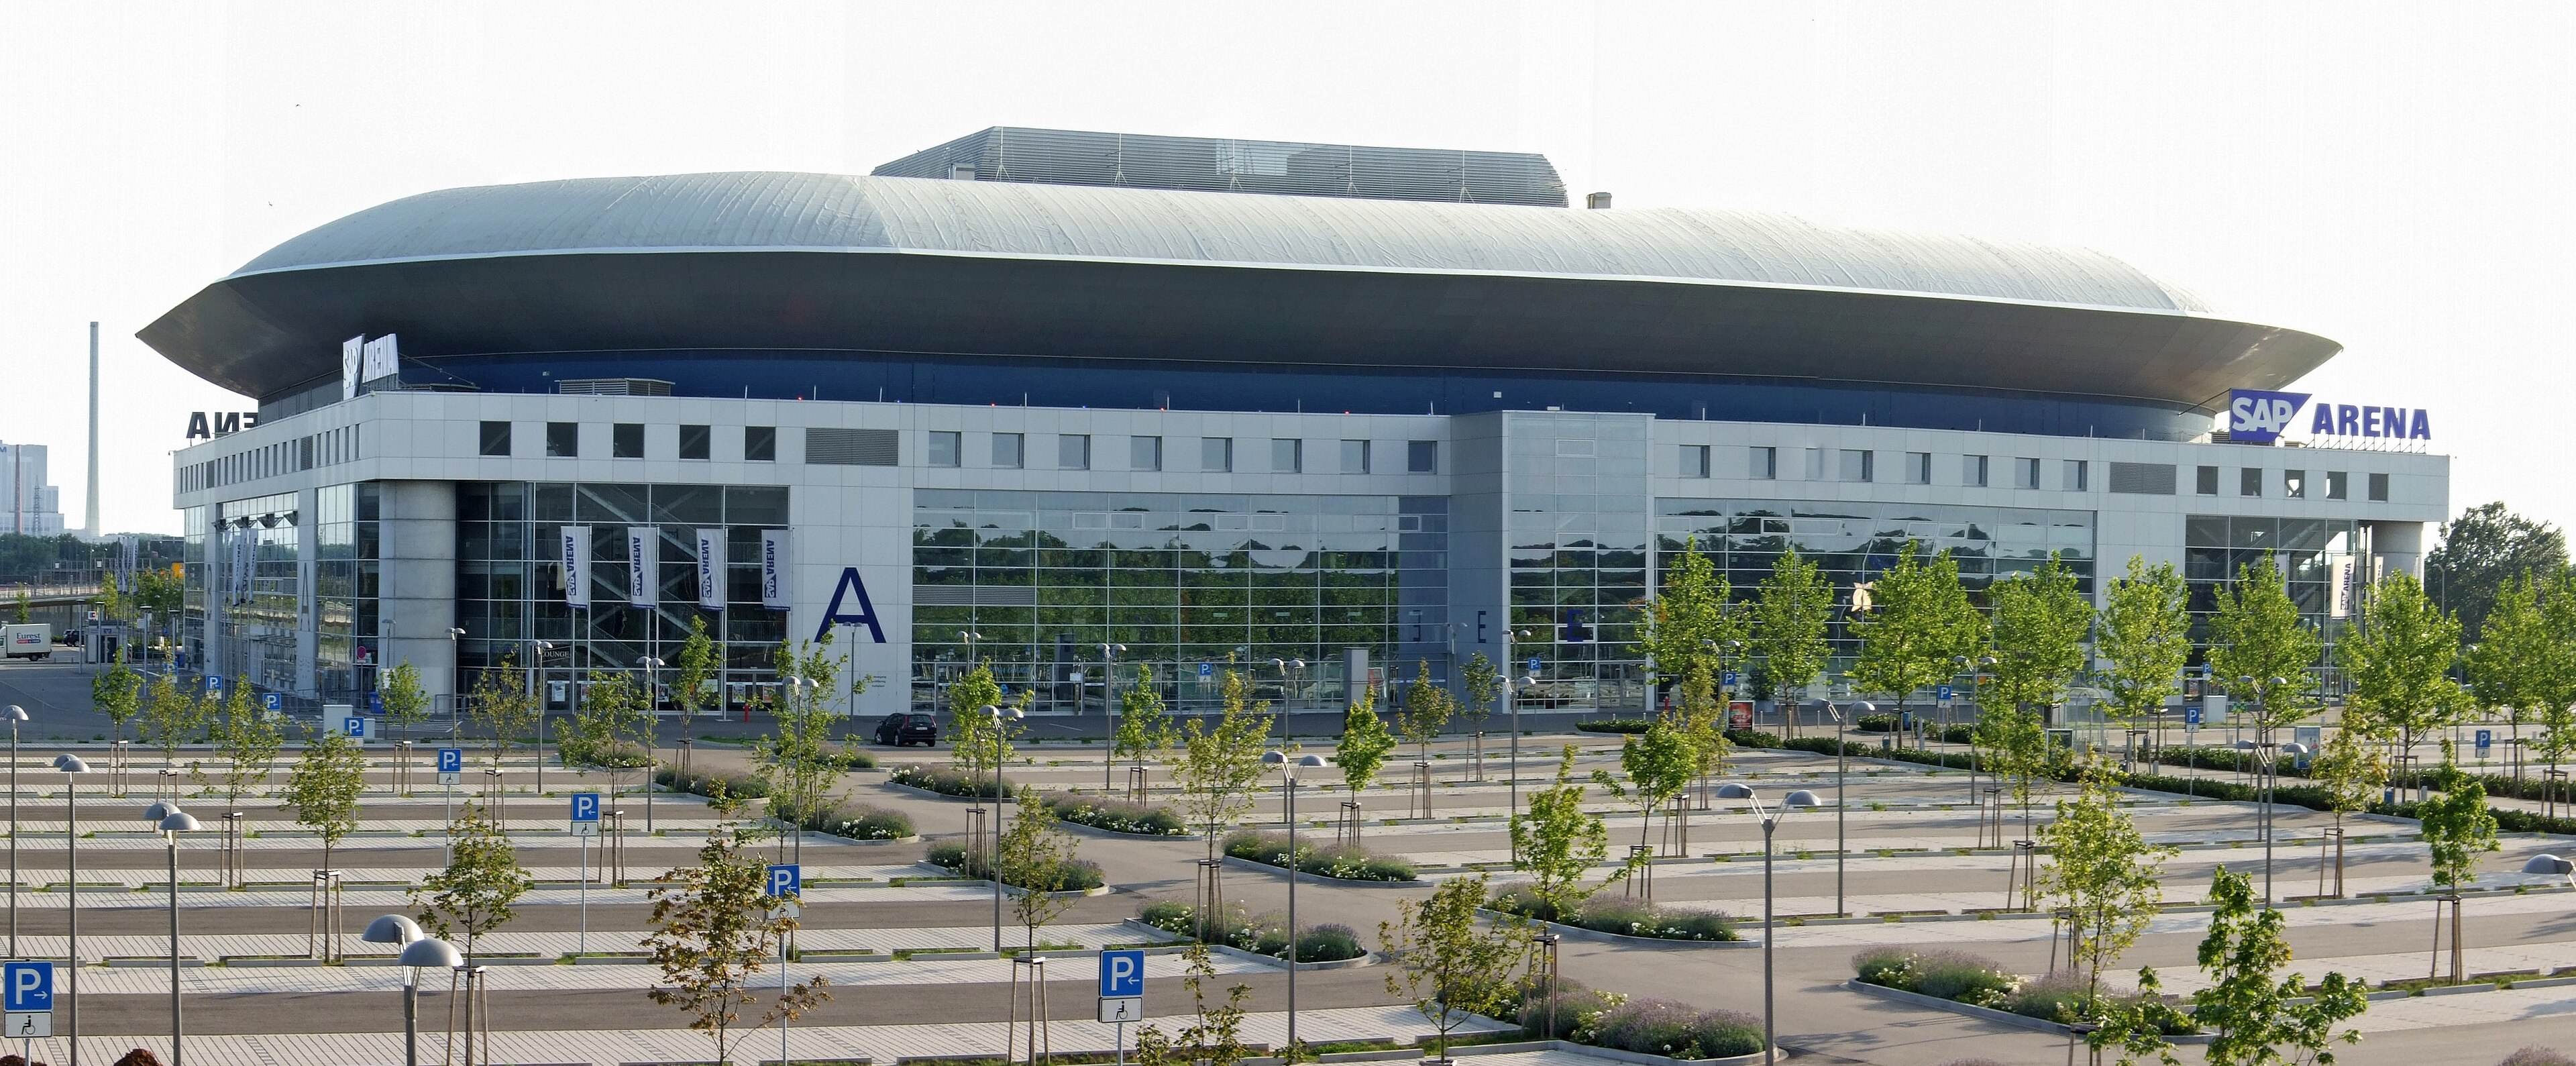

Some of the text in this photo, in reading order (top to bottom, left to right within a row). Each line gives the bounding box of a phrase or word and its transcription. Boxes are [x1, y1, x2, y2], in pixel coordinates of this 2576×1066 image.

[343, 333, 398, 389] SAP ARENA
[2232, 396, 2431, 440] SAP ARENA
[2343, 563, 2351, 592] ARENA
[301, 562, 310, 632] A
[814, 567, 887, 643] A
[1478, 610, 1487, 643] E
[1201, 663, 1208, 674] P
[1531, 659, 1537, 670] P
[2204, 663, 2210, 673] P
[210, 677, 218, 689] P
[1725, 674, 1733, 684] P
[267, 695, 276, 708] P
[1941, 687, 1949, 698] P
[2189, 709, 2197, 722] P
[349, 719, 360, 735] P
[2480, 733, 2488, 746] P
[443, 751, 456, 769] P
[578, 796, 592, 817] P
[774, 869, 792, 897] P
[1112, 957, 1134, 991] P
[16, 969, 41, 1005] P
